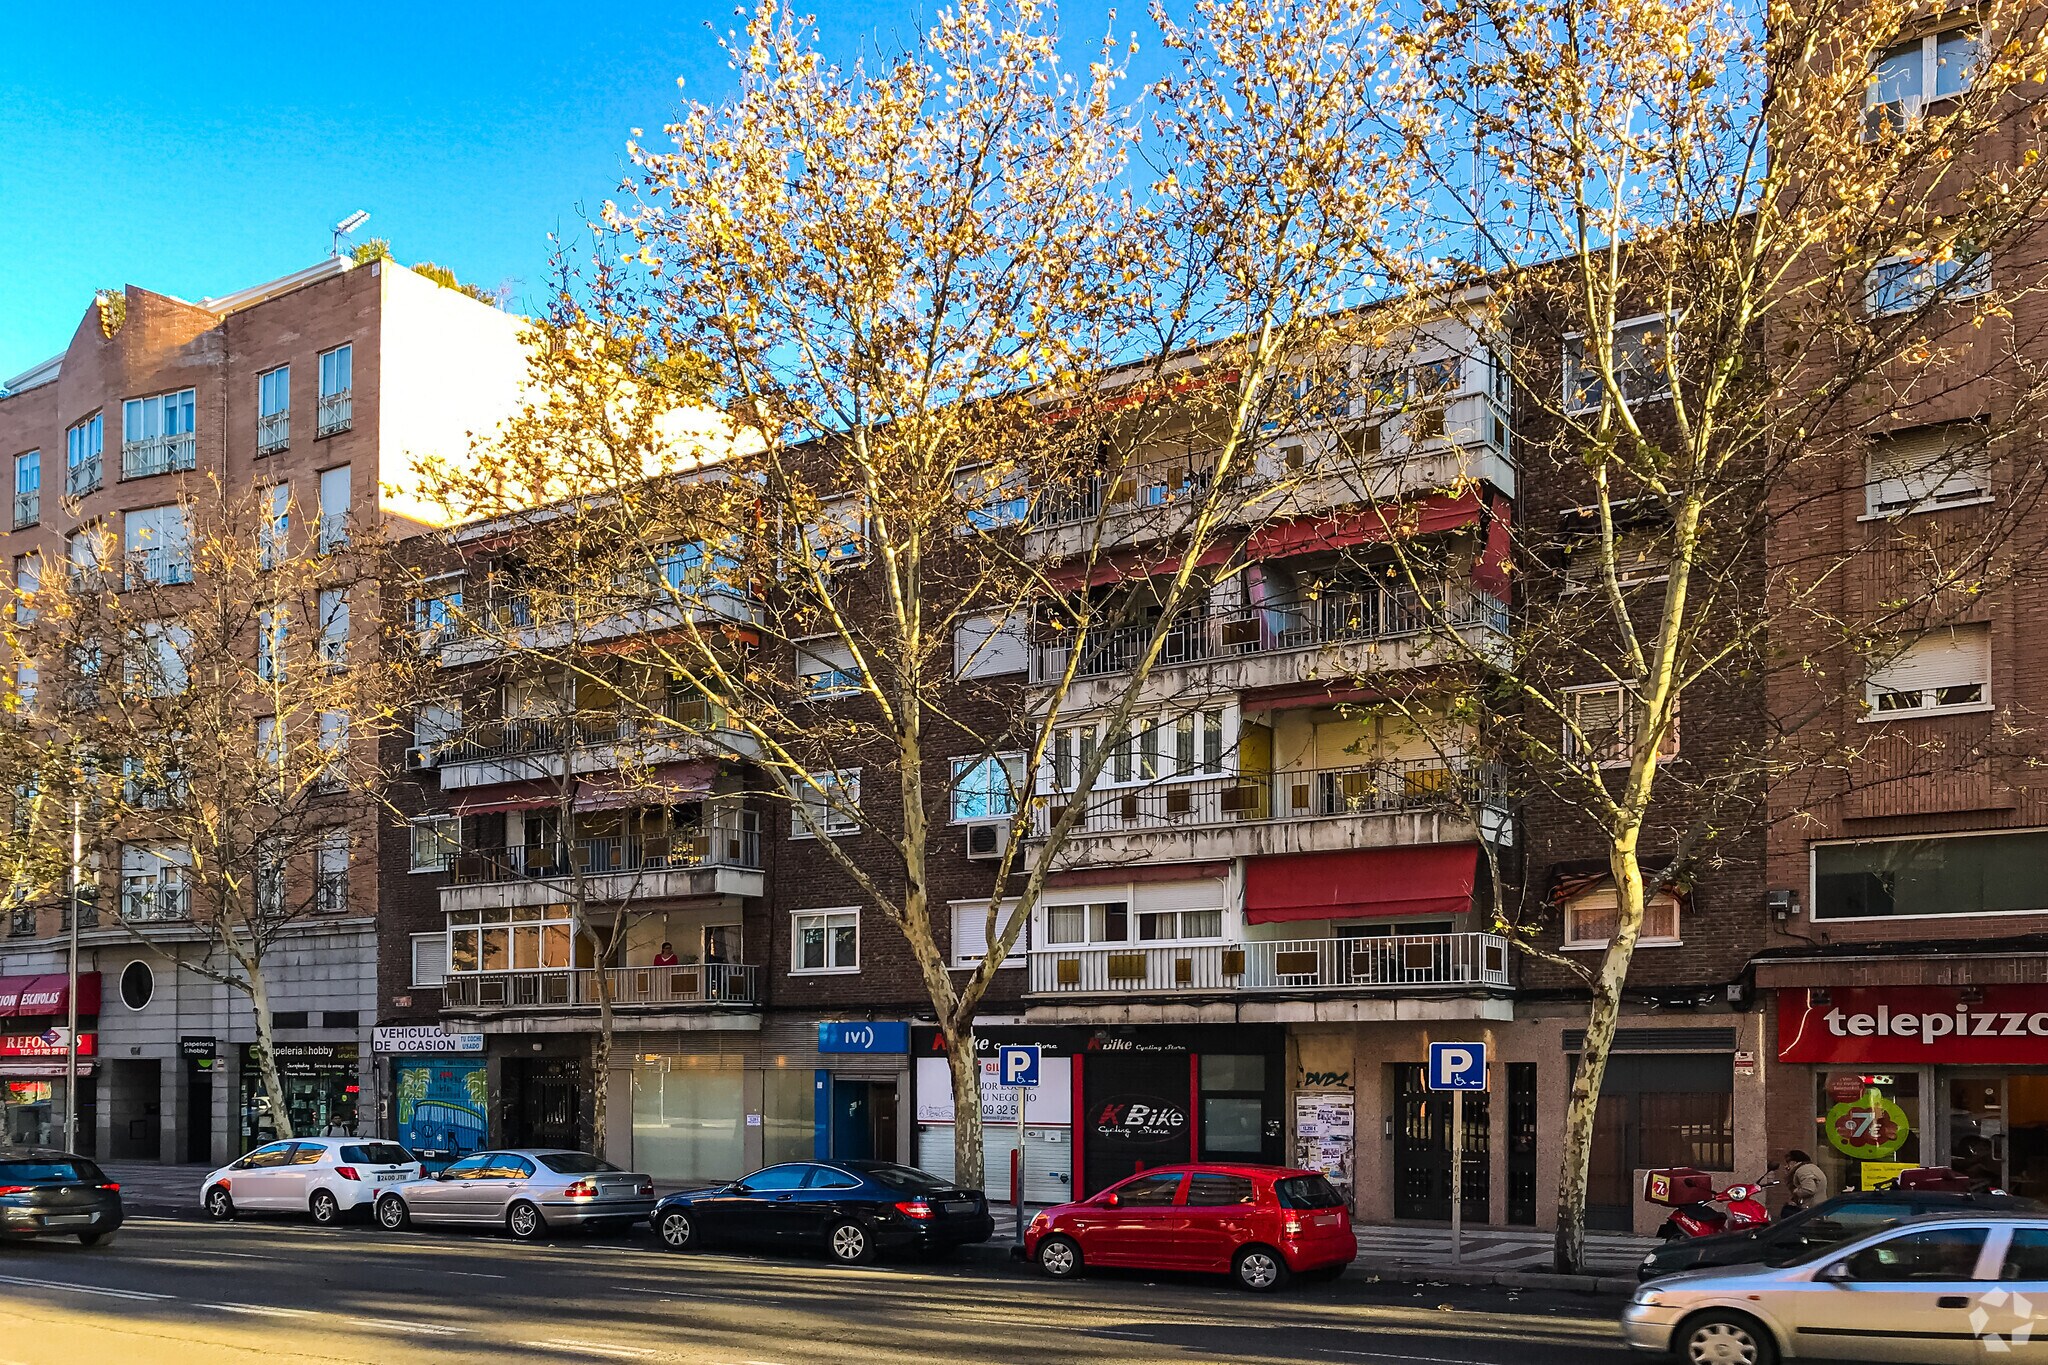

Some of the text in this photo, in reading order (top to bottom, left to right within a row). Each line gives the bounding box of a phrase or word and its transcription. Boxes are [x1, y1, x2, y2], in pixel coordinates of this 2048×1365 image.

[0, 992, 60, 1007] ION ESCAYOLAS
[380, 1028, 451, 1038] VEHICULO
[272, 1045, 334, 1057] apeleria&hobby
[375, 1040, 456, 1051] DE OCASION
[1007, 1051, 1031, 1082] P
[1441, 1049, 1473, 1084] P
[992, 1093, 1037, 1102] NEGOIO
[997, 1105, 1007, 1114] 32
[1010, 1105, 1018, 1115] 5
[1099, 1104, 1184, 1126] K Bike
[1098, 1125, 1170, 1138] Cycling Store
